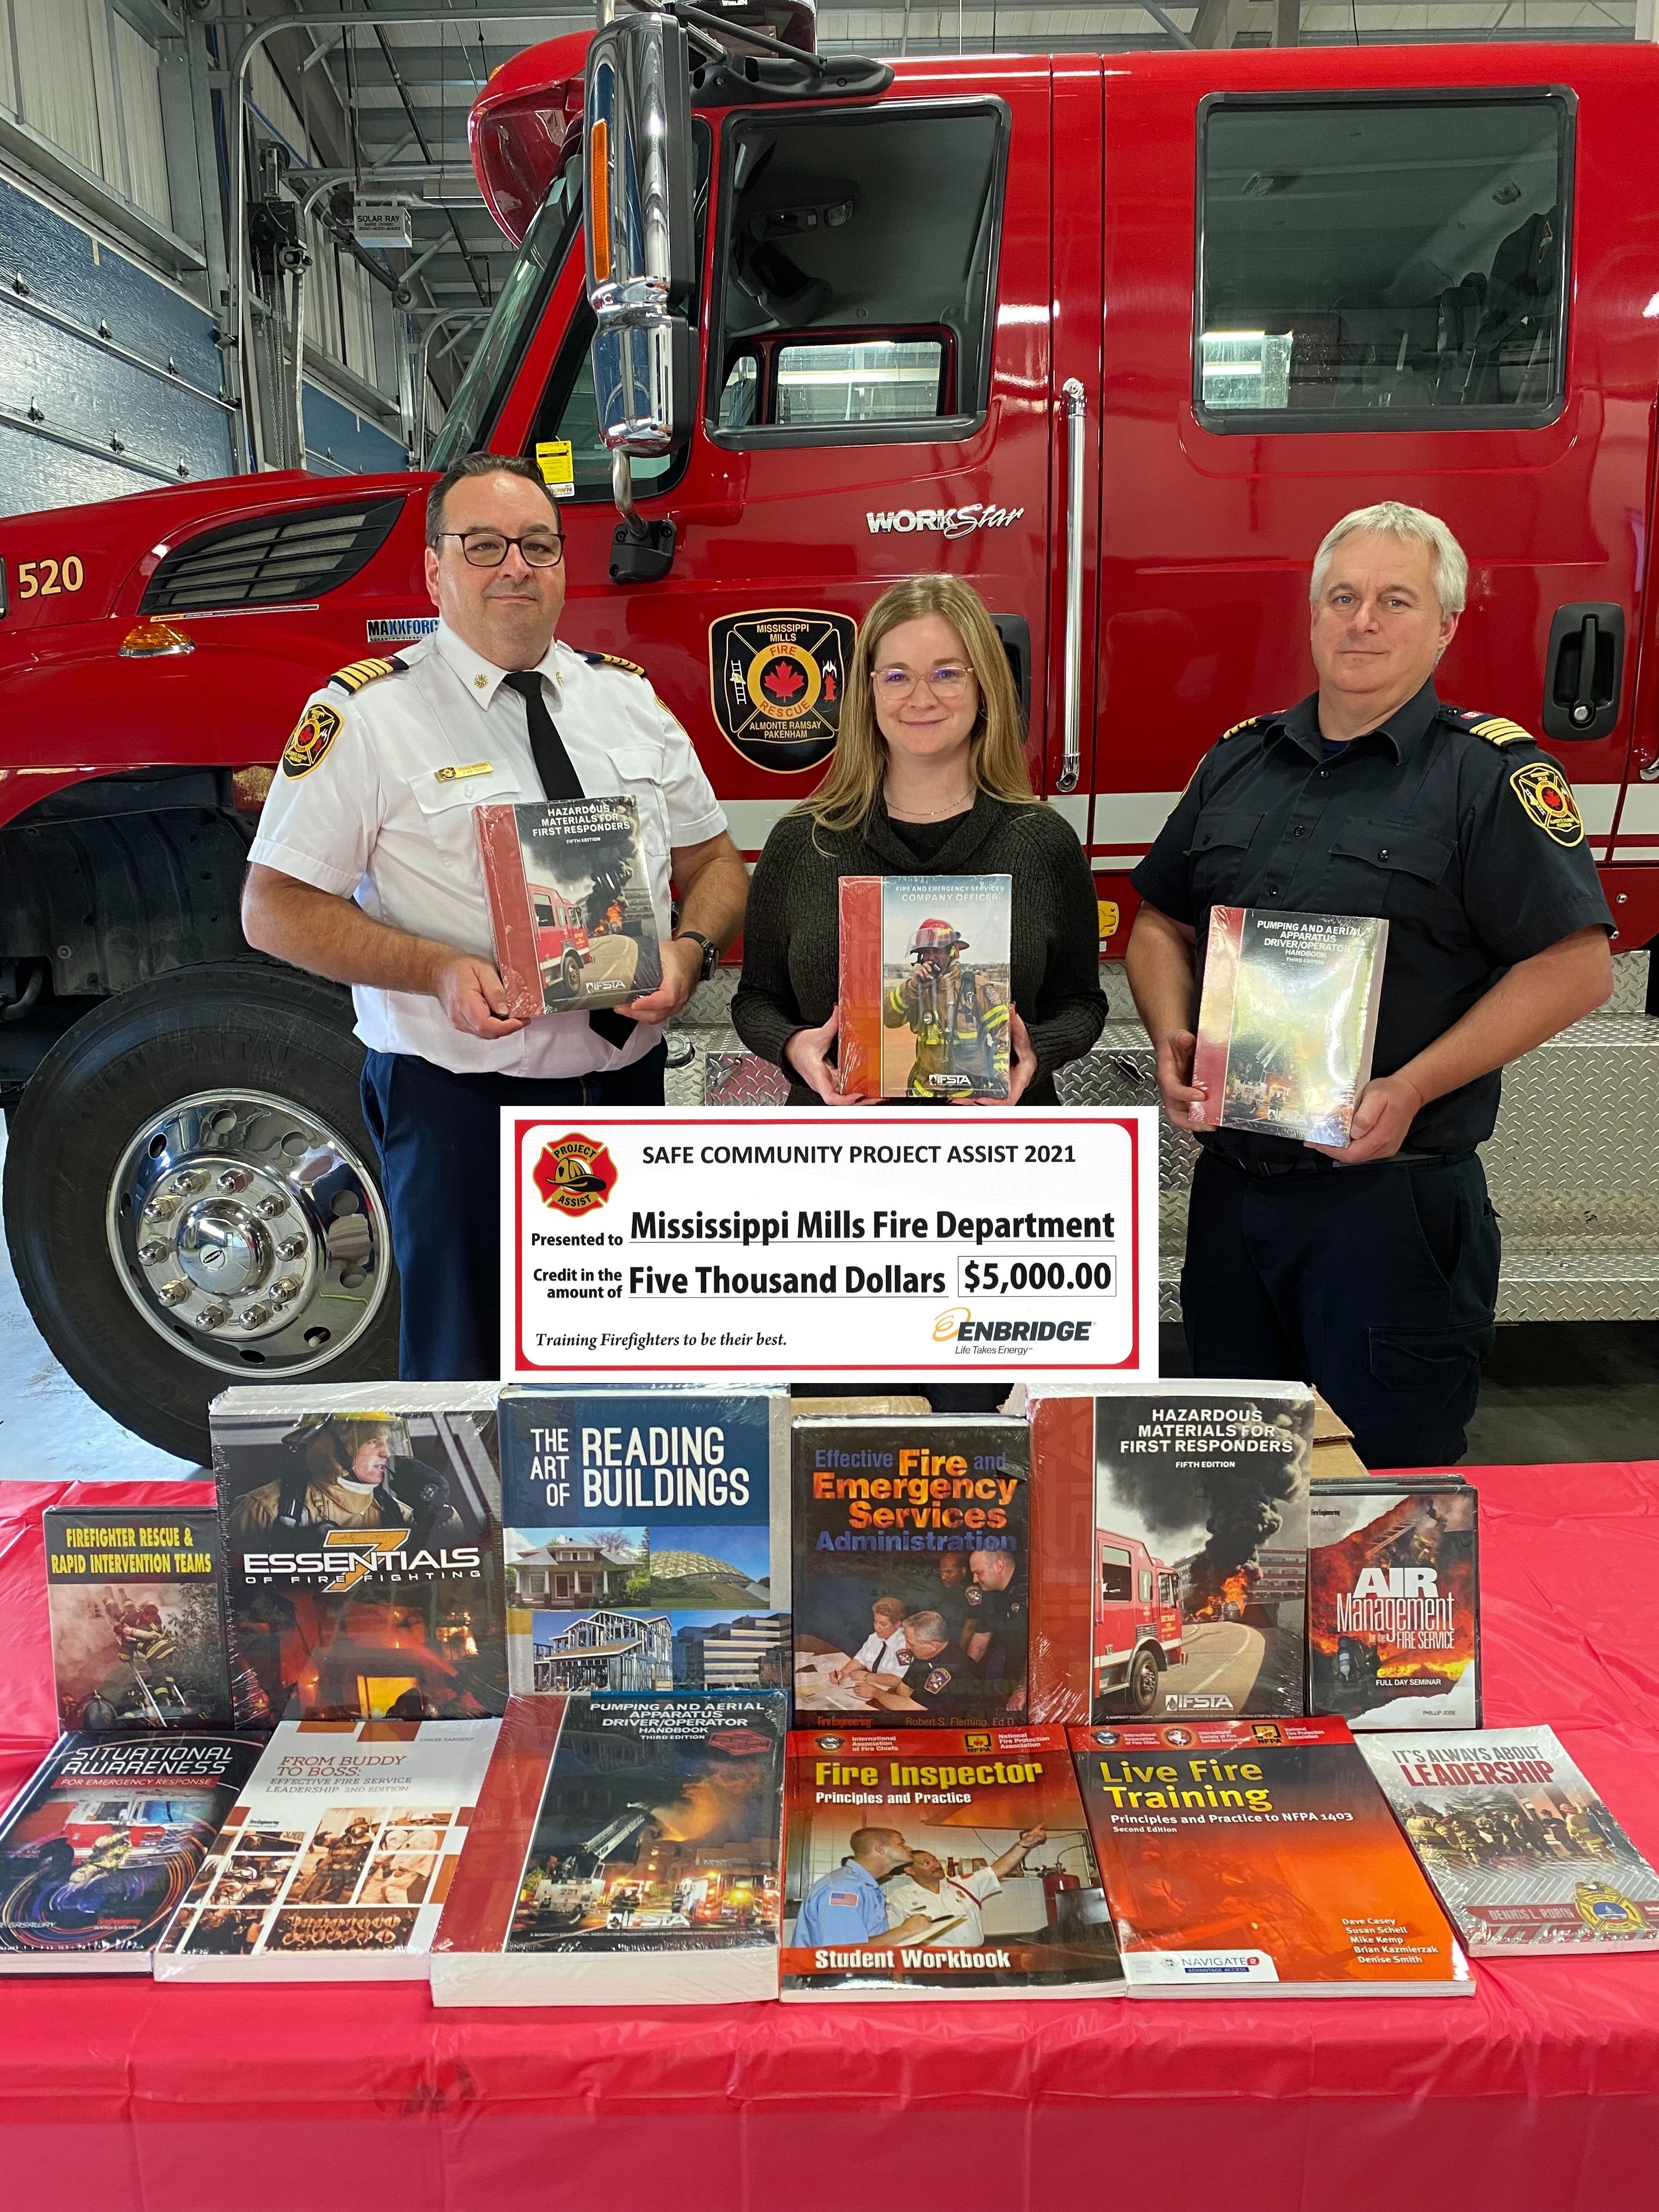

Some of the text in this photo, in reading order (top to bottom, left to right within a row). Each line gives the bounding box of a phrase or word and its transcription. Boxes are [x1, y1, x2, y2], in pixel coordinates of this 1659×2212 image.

[18, 555, 84, 599] 520
[368, 619, 439, 635] MAXXFORC
[757, 624, 809, 633] MISSISSIPPI
[770, 634, 797, 642] MILLS
[769, 645, 797, 656] FIRE
[759, 700, 810, 717] RESCUE
[749, 721, 822, 730] ALMONTE RAMSAY
[764, 730, 808, 738] PAKENHAM
[548, 804, 610, 816] HAZARDOUS
[541, 815, 598, 826] MATERIALS
[532, 822, 630, 837] FIRST RESPONDERS
[901, 894, 998, 902] COMPANY OFFICER
[1257, 920, 1323, 933] PUMPING AND
[1279, 931, 1336, 943] APPARATUS
[1264, 938, 1351, 953] DRIVER/OPERATOR
[1285, 949, 1327, 958] HANDBOOK
[1152, 1409, 1262, 1422] HAZARDOUS
[1138, 1425, 1276, 1437] MATERIALS FOR
[531, 1428, 568, 1452] THE
[582, 1426, 724, 1466] READING
[1120, 1440, 1293, 1453] FIRST RESPONDERS
[530, 1455, 569, 1480] ART
[815, 1448, 1006, 1477] Effective Fire and
[584, 1468, 749, 1507] BUILDINGS
[813, 1471, 1018, 1505] Emergency
[546, 1483, 571, 1507] OF
[849, 1500, 1007, 1529] Services
[66, 1527, 180, 1548] FIREFIGHTER RESCUE
[815, 1530, 1017, 1552] Administration
[51, 1553, 212, 1573] RAPID INTERVENTION TEAMS
[243, 1547, 481, 1573] ESSENTIALS
[321, 1528, 411, 1593] 7
[245, 1570, 481, 1584] OF FIRE FIGHTING
[1352, 1567, 1438, 1599] AIR
[1336, 1592, 1454, 1643] Management
[1397, 1631, 1454, 1649] FIRE SERVICE
[1178, 1694, 1234, 1708] IFSTA
[602, 1718, 748, 1727] DRIVER/OPERATOR
[70, 1747, 233, 1761] SITUATIONAL
[280, 1755, 408, 1767] FROM BUDDY
[1426, 1748, 1492, 1763] ALWAYS
[1492, 1746, 1544, 1760] ABOUT
[61, 1761, 227, 1775] AWARENESS
[277, 1766, 362, 1777] TO BOSS:
[1099, 1759, 1263, 1784] Live Fire
[1400, 1761, 1554, 1787] LEADERSHIP
[816, 1761, 1043, 1790] Fire Inspector
[816, 1792, 971, 1805] Principles and Practice
[1103, 1785, 1273, 1812] Training
[1111, 1812, 1353, 1825] Principles and Practice to NFPA 1403
[1367, 1917, 1396, 1927] Casey
[1376, 1926, 1408, 1934] Schell
[1375, 1936, 1403, 1945] Kemp
[1354, 1945, 1438, 1954] Brian Kazmierzak
[815, 1949, 1011, 1969] Student Workbook
[1392, 1955, 1423, 1963] Smith
